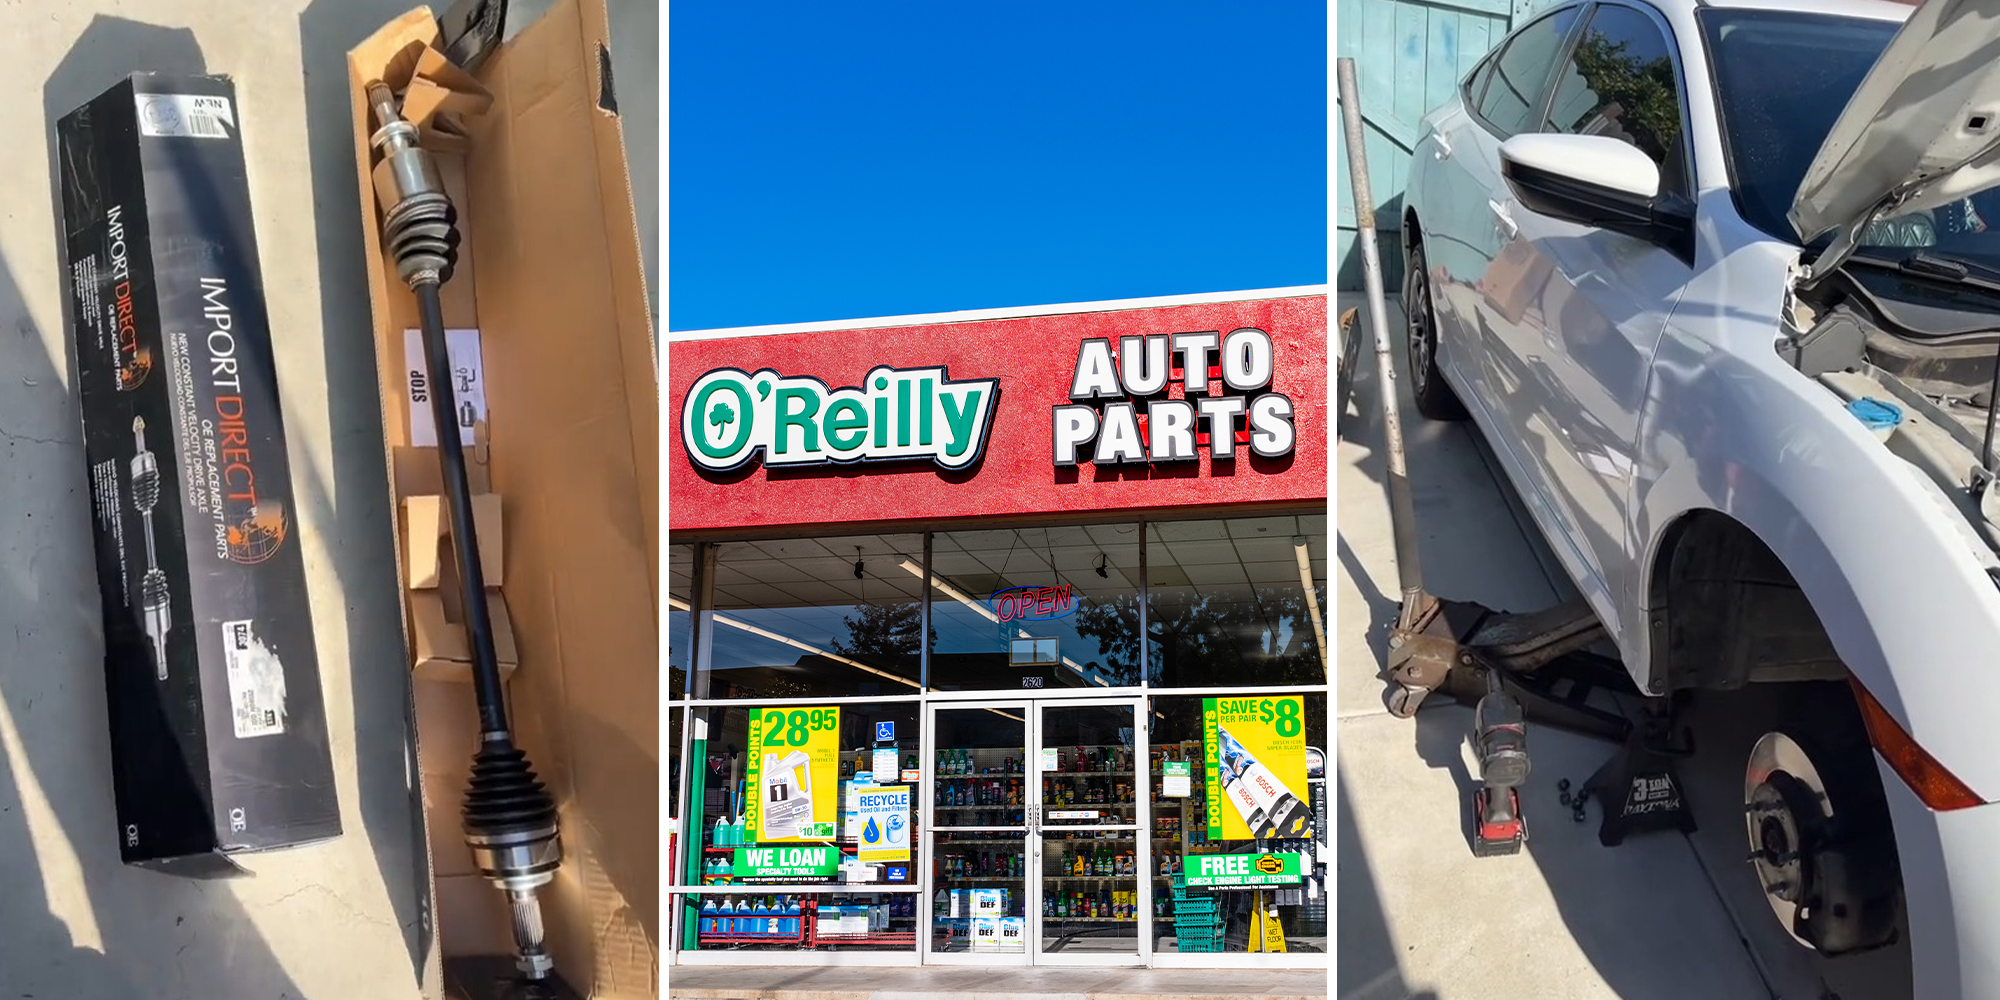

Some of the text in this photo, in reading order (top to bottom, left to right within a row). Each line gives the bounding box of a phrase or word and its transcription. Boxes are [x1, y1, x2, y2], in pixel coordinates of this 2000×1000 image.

[109, 316, 121, 367] REPLACEMENT
[115, 369, 123, 391] PARTS
[1070, 329, 1273, 399] AUTO
[412, 370, 426, 403] STOP
[170, 332, 197, 506] NUEVO VELOCIDAD CONSTANTE DEL EJE PROPULSOR
[178, 332, 208, 513] NEW CONSTANT VELOCITY DRIVE AXLE
[690, 375, 982, 457] O'Reilly
[1054, 393, 1296, 466] PARTS
[202, 419, 229, 560] OE REPLACEMENT PARTS
[998, 584, 1071, 622] OPEN
[1023, 677, 1043, 687] 2620
[1220, 699, 1300, 737] SAVE $8
[1220, 713, 1256, 723] PER PAIR
[746, 720, 760, 830] DOUBLE POINTS
[1205, 710, 1221, 827] DOUBLE POINTS
[1239, 788, 1255, 808] BOSCH
[1256, 775, 1276, 799] BOSCH
[1634, 778, 1648, 801] 3
[1648, 778, 1670, 791] TON
[860, 794, 907, 806] RECYCLE
[799, 827, 812, 836] $10
[822, 827, 833, 836] gift
[746, 849, 825, 867] WE LOAN
[1201, 856, 1249, 876] FREE
[1188, 875, 1299, 885] CHECK ENGINE LIGHT TESTING
[1267, 935, 1281, 943] FLOOR
[1268, 928, 1278, 936] WET
